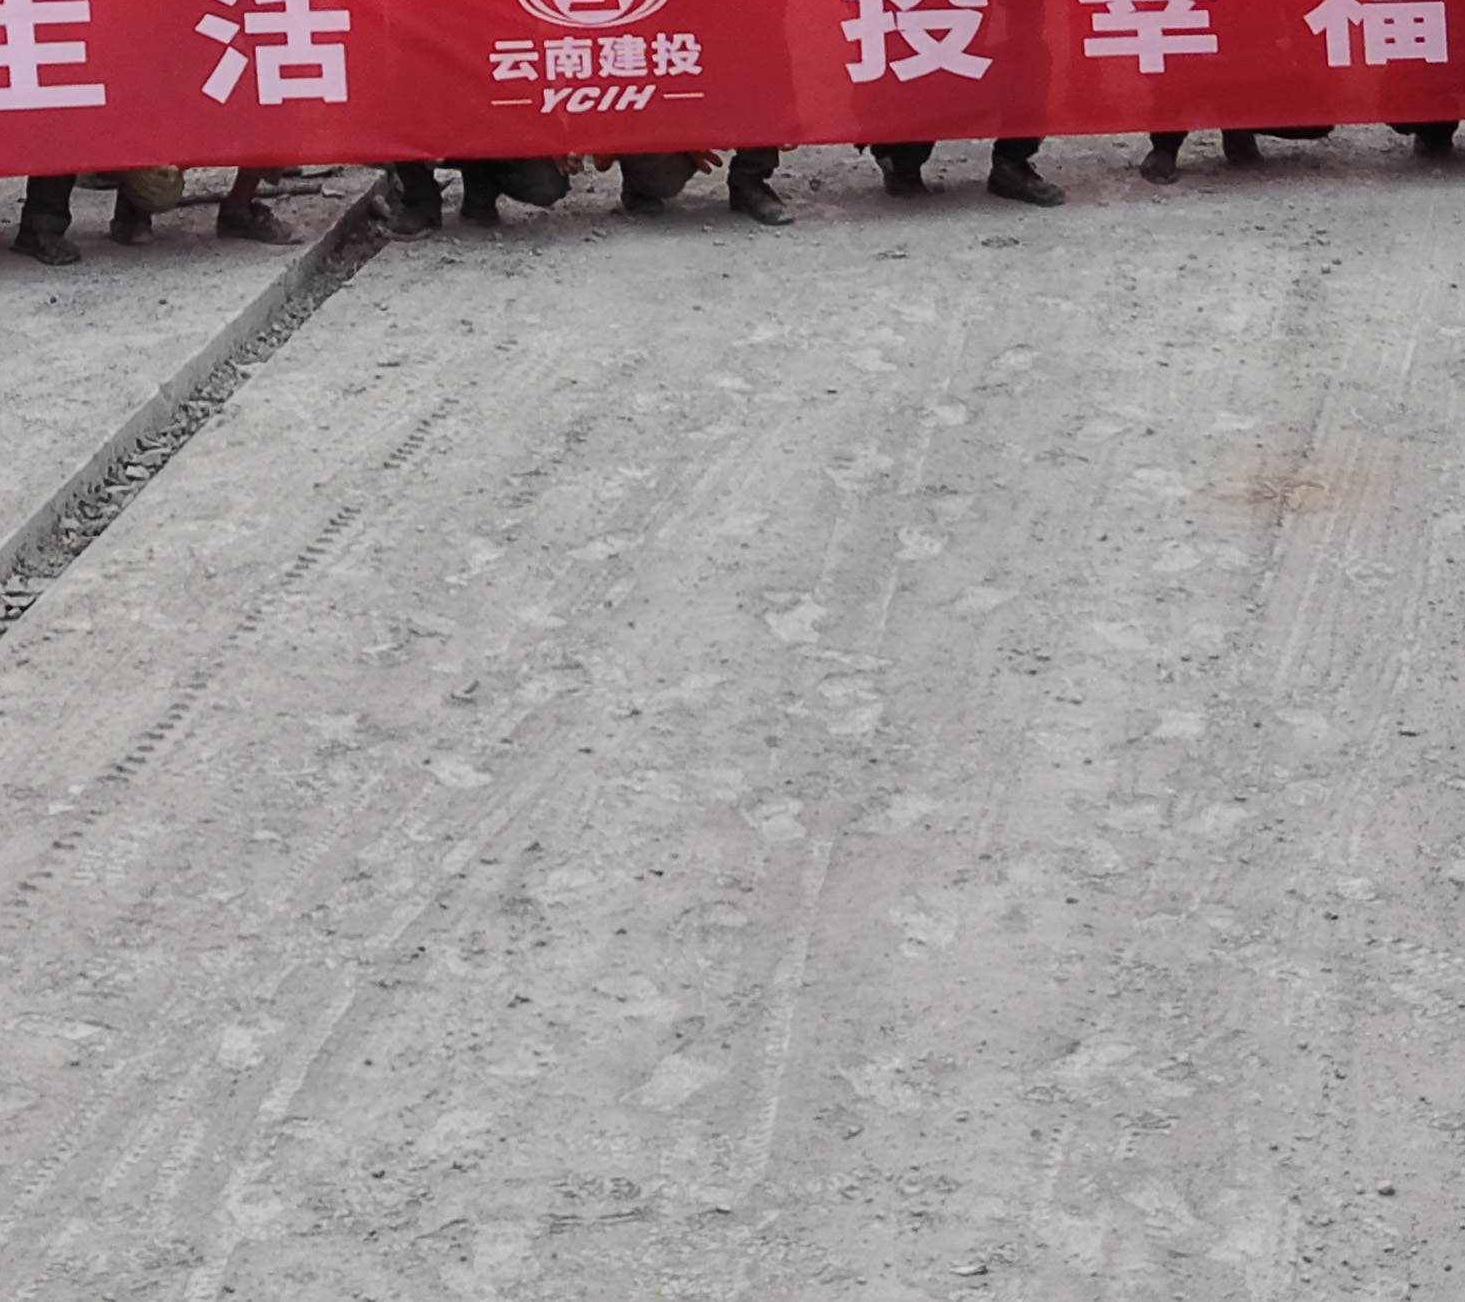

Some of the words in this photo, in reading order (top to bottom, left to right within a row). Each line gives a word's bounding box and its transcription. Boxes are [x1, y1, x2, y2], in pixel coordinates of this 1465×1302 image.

[489, 32, 703, 81] 云南建投
[540, 84, 657, 113] YCIH
